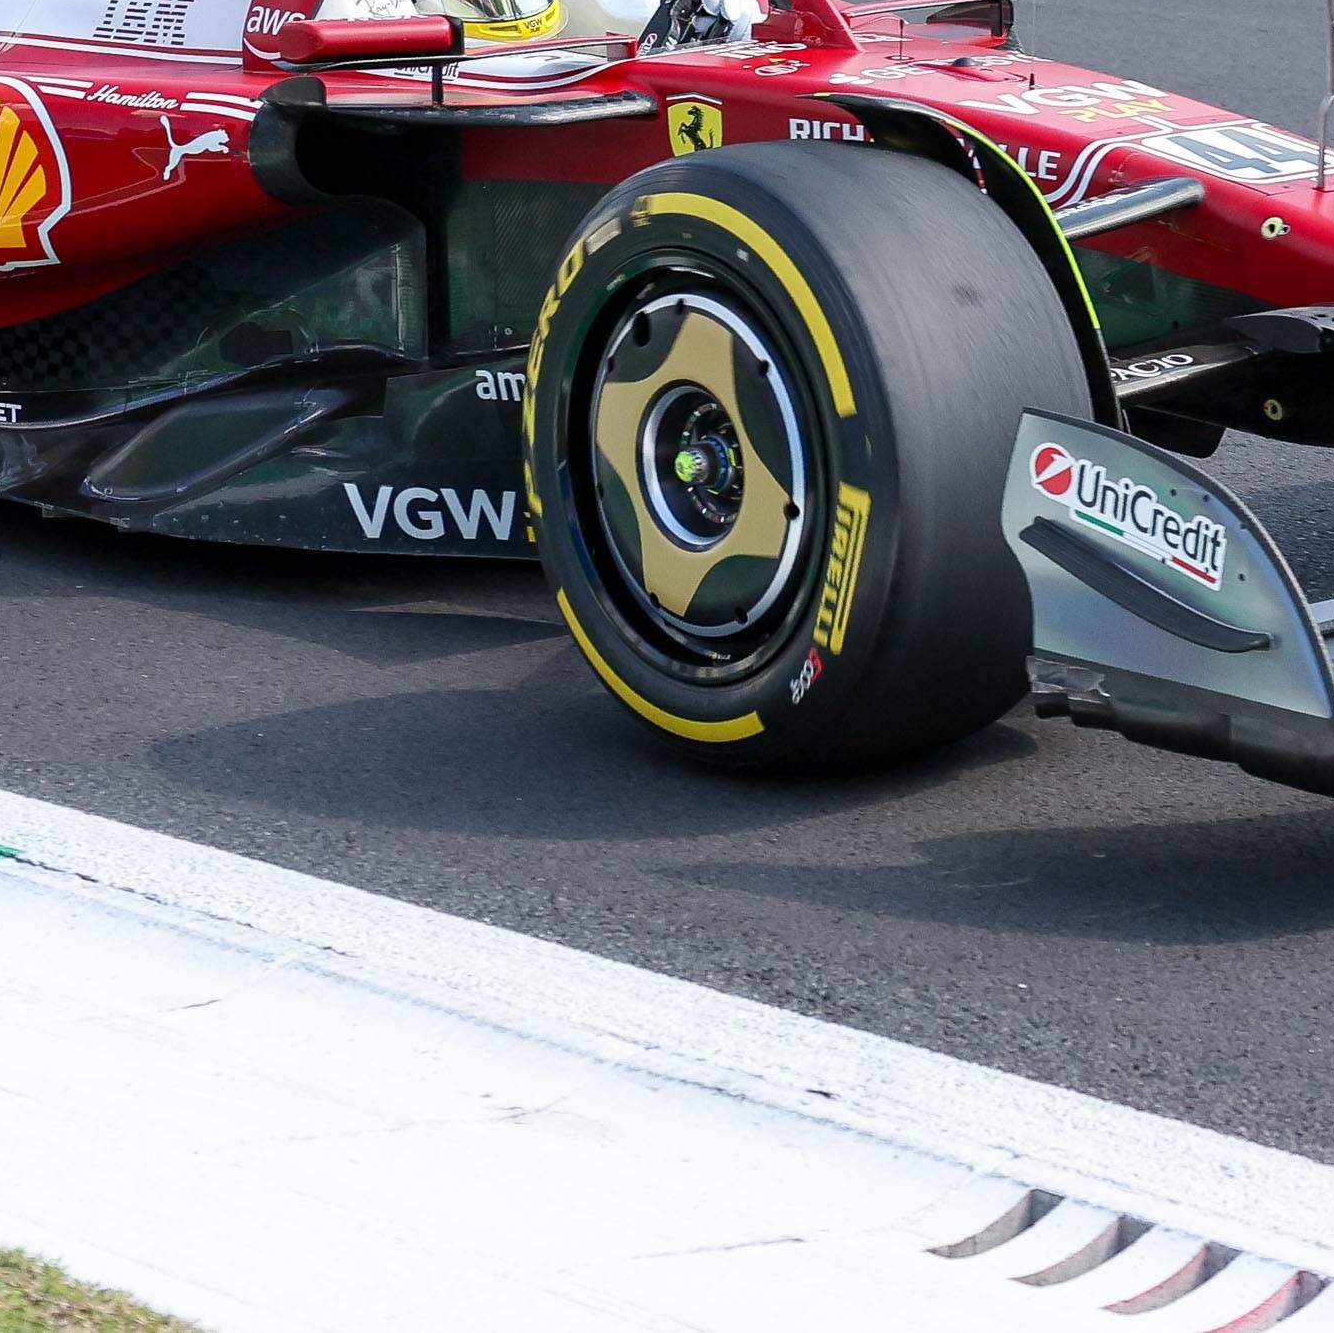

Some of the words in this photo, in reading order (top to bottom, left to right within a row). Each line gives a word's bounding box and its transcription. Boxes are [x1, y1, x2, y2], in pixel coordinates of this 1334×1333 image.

[87, 81, 180, 113] Hamilton
[955, 79, 1170, 115] VGW
[1167, 128, 1333, 174] 44
[343, 482, 517, 542] VGW
[1076, 461, 1226, 573] UniCredit
[811, 481, 872, 656] PIRELLI
